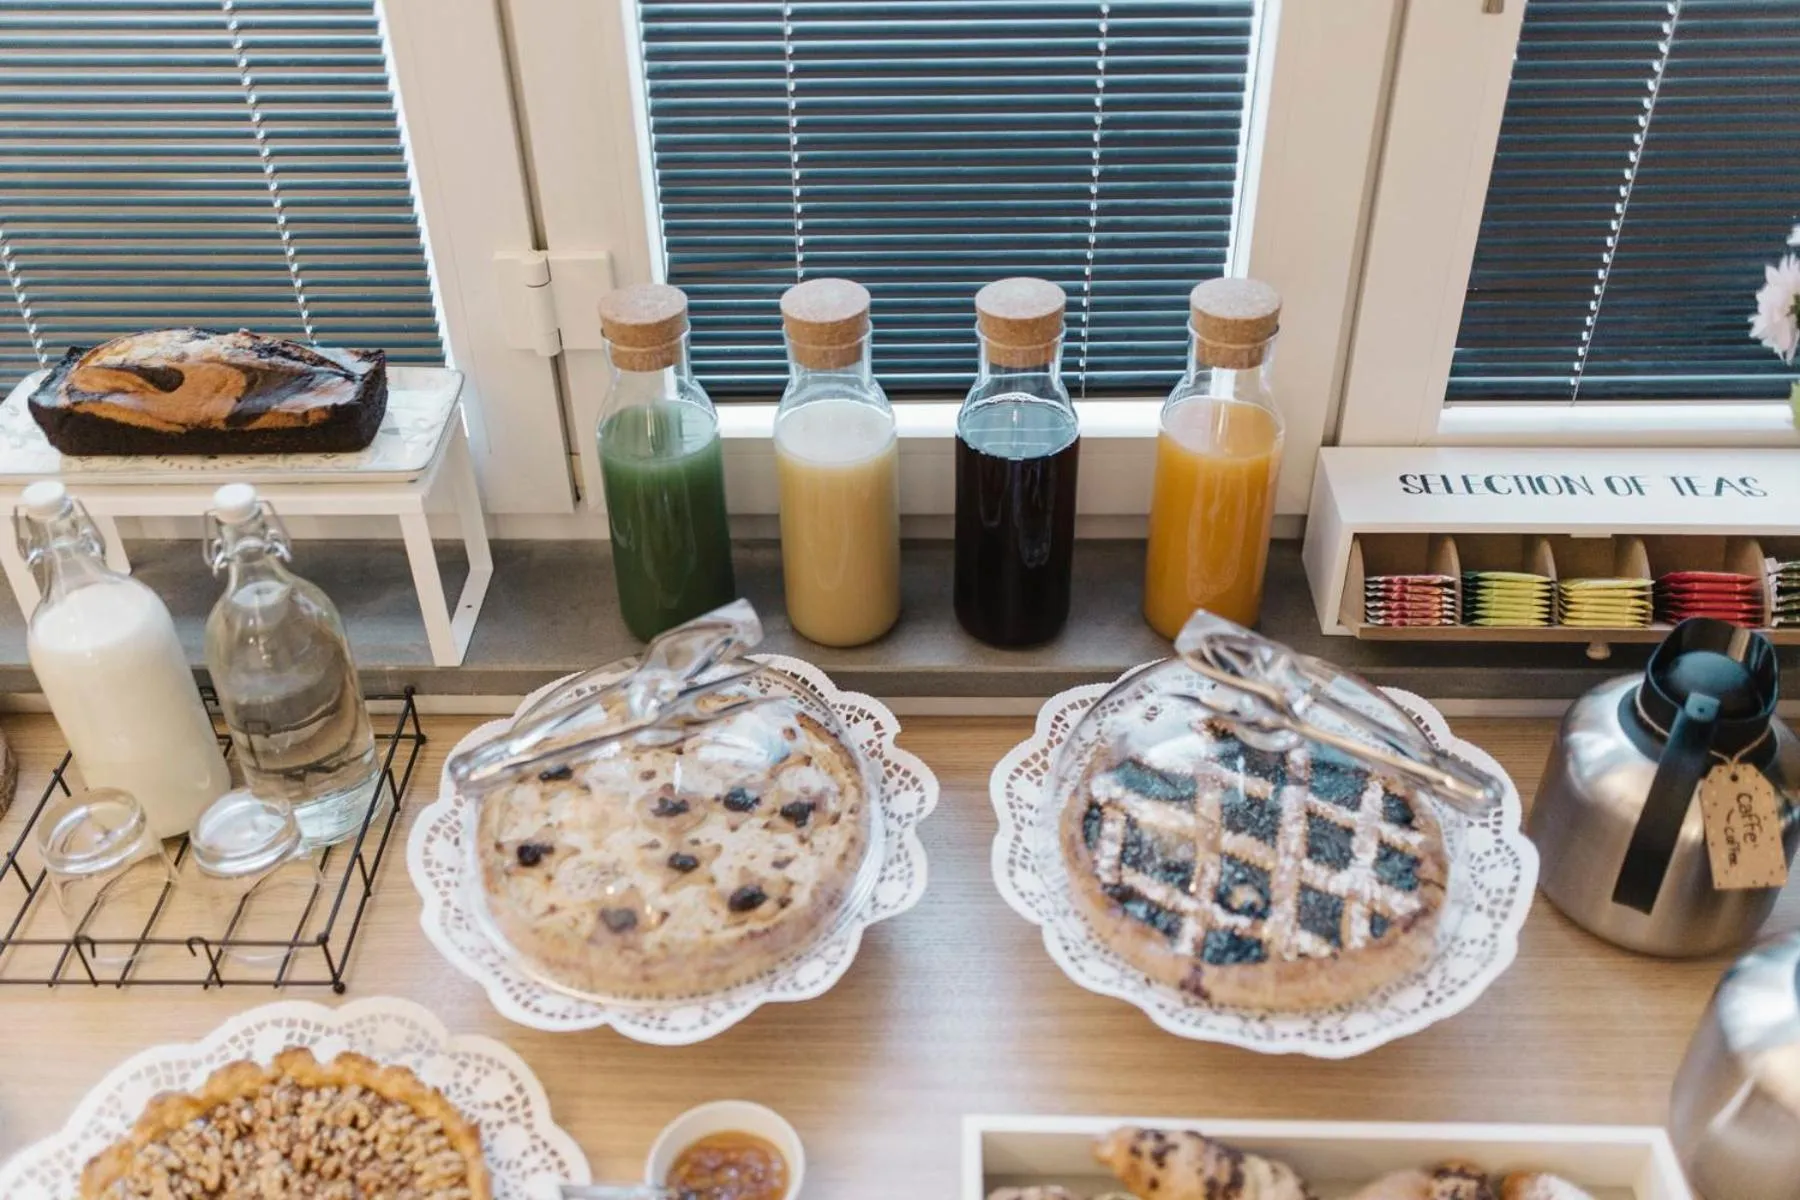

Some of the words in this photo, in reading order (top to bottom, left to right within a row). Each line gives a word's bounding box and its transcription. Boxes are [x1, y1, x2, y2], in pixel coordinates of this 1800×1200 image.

[1398, 473, 1594, 496] SELECTION
[1603, 475, 1651, 497] OF
[1664, 475, 1768, 497] TEAS
